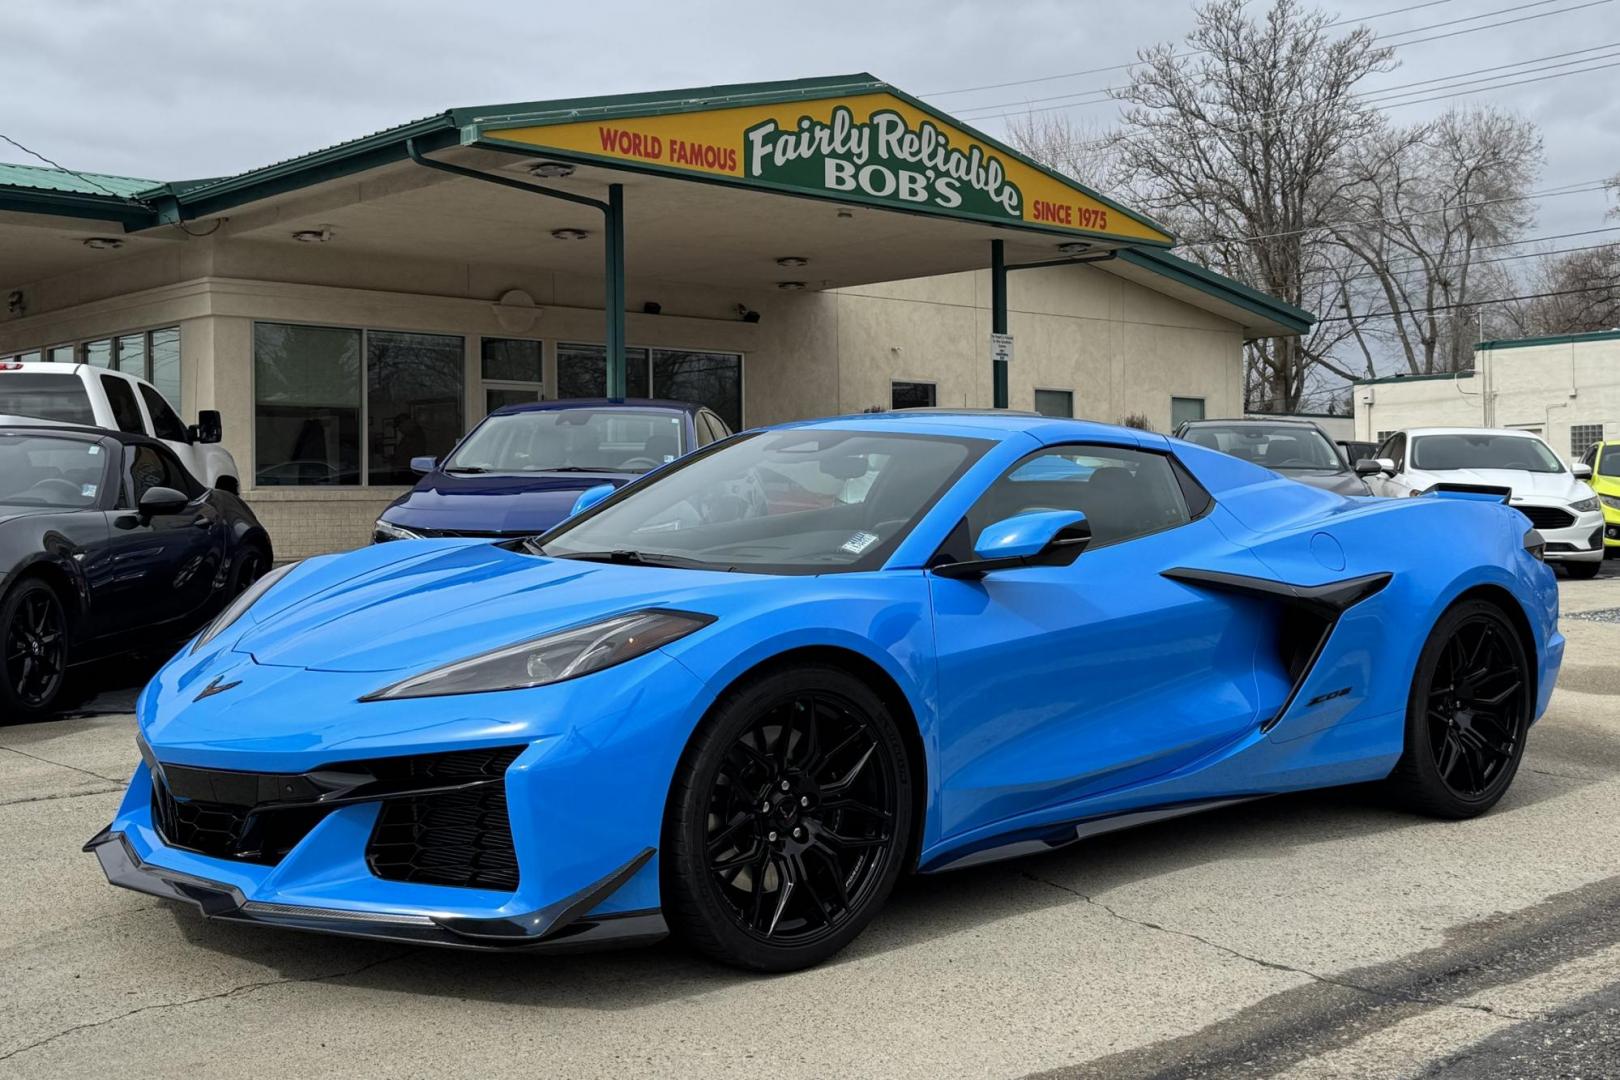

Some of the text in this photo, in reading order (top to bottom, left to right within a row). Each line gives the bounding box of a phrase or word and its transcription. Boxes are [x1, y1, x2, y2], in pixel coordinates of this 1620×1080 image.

[598, 126, 737, 172] WORLD FAMOUS
[748, 109, 1021, 217] Fairly Reliable
[824, 157, 962, 208] BOB'S
[1032, 199, 1107, 230] SINCE 1975
